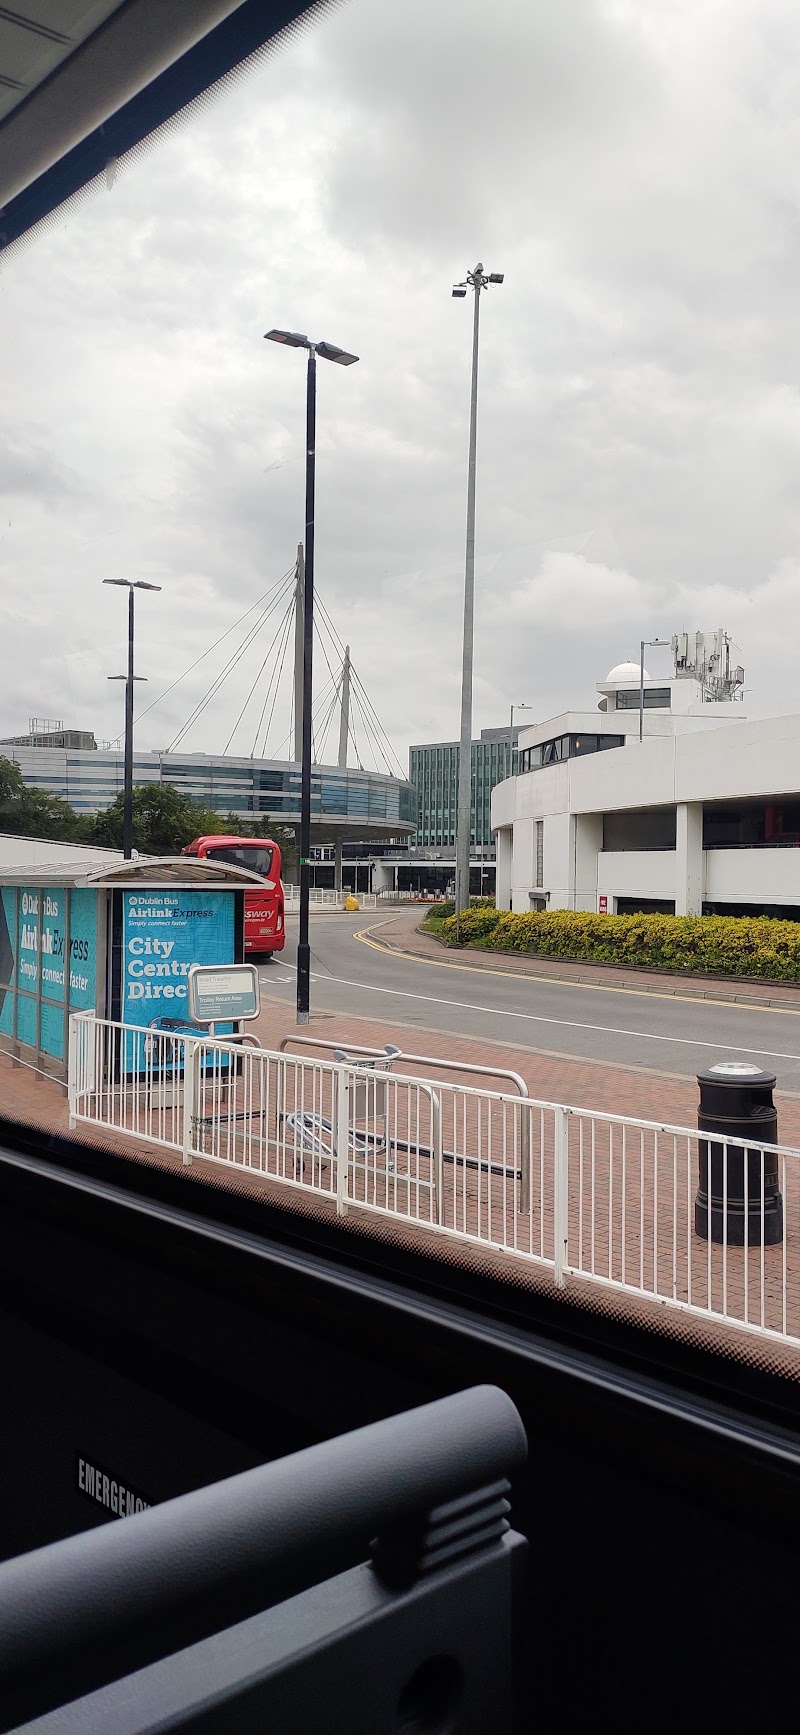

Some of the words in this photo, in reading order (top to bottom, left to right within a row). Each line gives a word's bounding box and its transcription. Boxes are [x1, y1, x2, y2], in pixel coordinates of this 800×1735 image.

[46, 896, 58, 917] Bus
[138, 897, 163, 905] Dublin
[164, 897, 178, 905] Bus
[128, 937, 175, 959] City
[20, 958, 38, 980] Simply
[42, 967, 65, 985] connect
[69, 970, 89, 991] faster
[127, 981, 189, 999] Direc
[78, 1458, 152, 1518] EMERGEN
